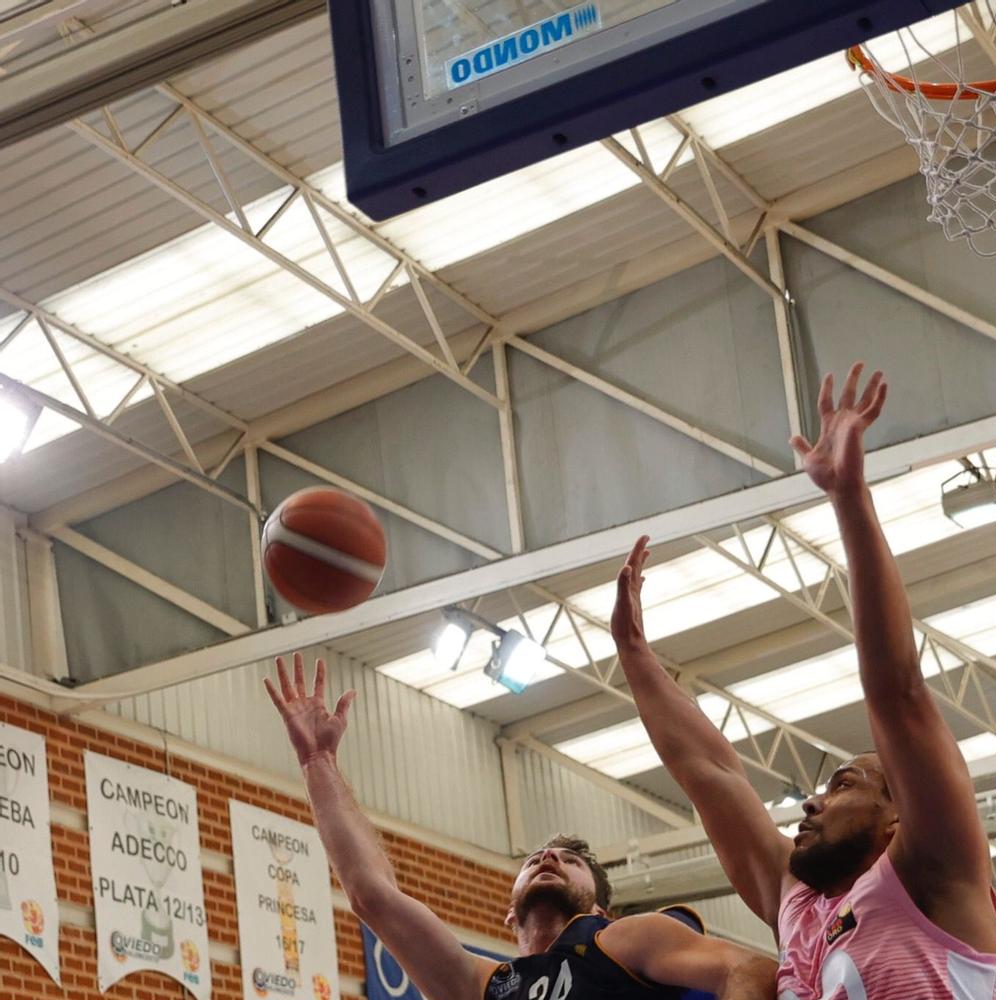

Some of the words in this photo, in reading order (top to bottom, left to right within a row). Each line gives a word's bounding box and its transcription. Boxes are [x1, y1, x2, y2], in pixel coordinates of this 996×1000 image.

[100, 778, 189, 824] CAMPEON
[111, 832, 188, 871] ADECCO
[251, 825, 310, 857] CAMPEON
[267, 864, 301, 886] COPA
[99, 877, 159, 912] PLATA
[164, 897, 205, 927] 12/13
[258, 894, 317, 924] PRINCESA
[111, 932, 161, 956] OVIEDO
[254, 968, 297, 990] OVIEDO
